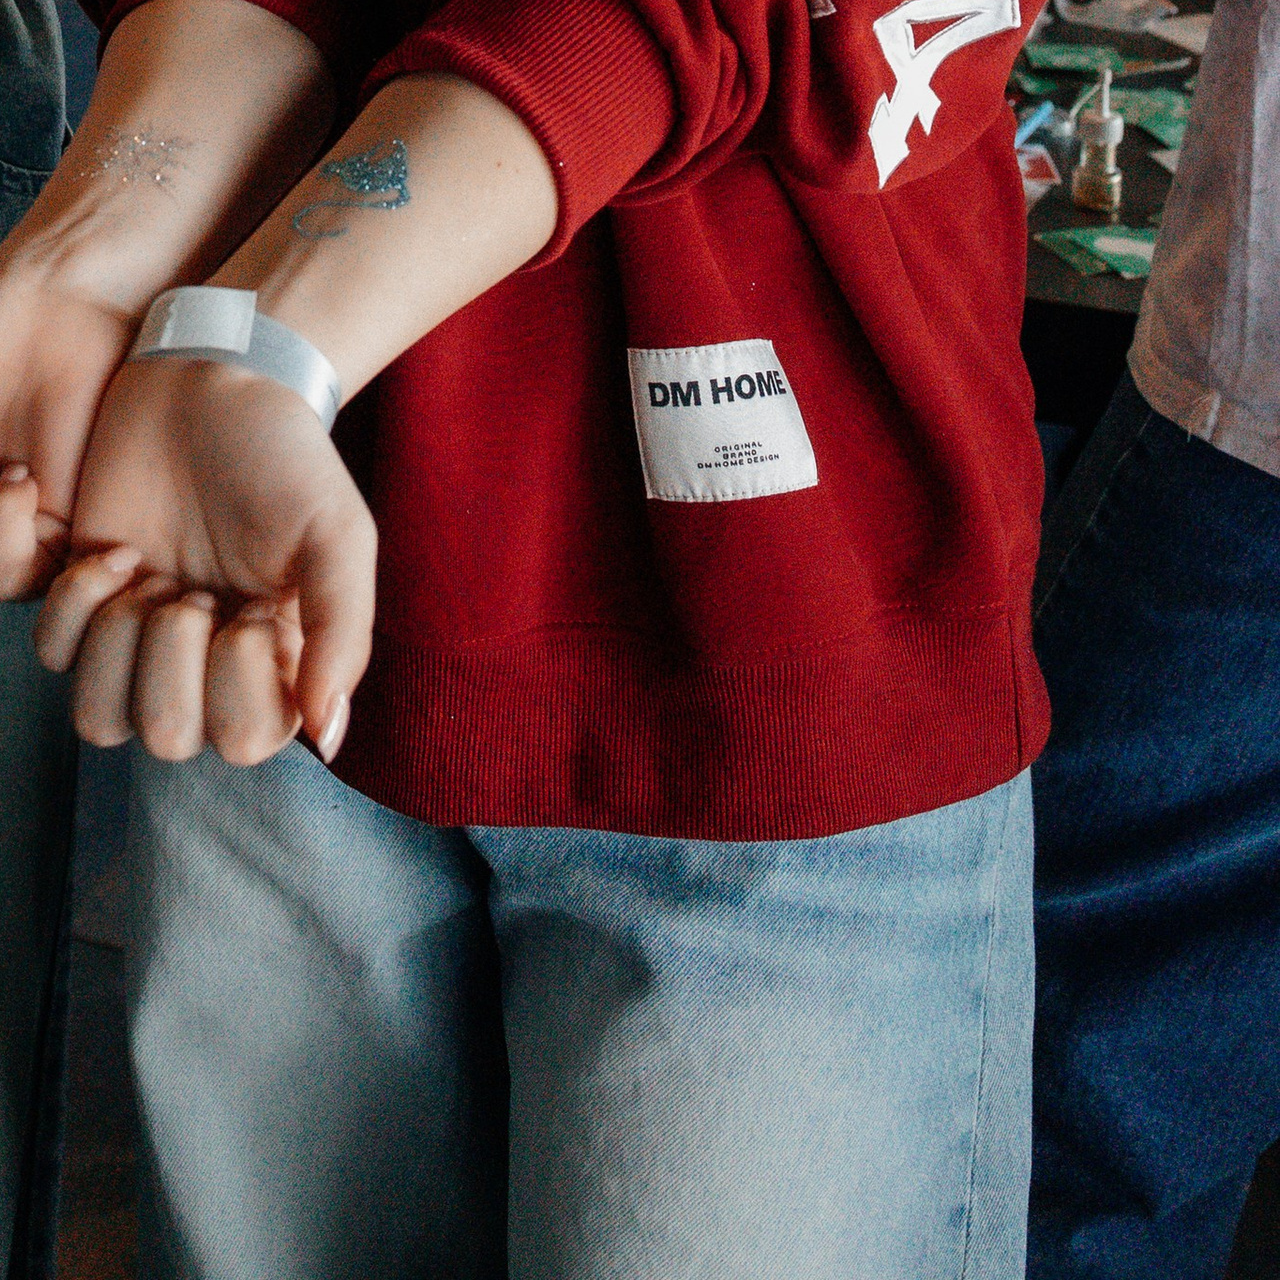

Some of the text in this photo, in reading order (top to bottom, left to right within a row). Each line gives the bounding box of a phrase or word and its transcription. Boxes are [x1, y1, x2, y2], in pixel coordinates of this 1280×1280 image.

[648, 370, 787, 407] DM HOME
[714, 441, 763, 453] ORIGINAL
[714, 459, 744, 468] HOME
[747, 454, 780, 465] DESIGN
[723, 449, 757, 460] BRAND
